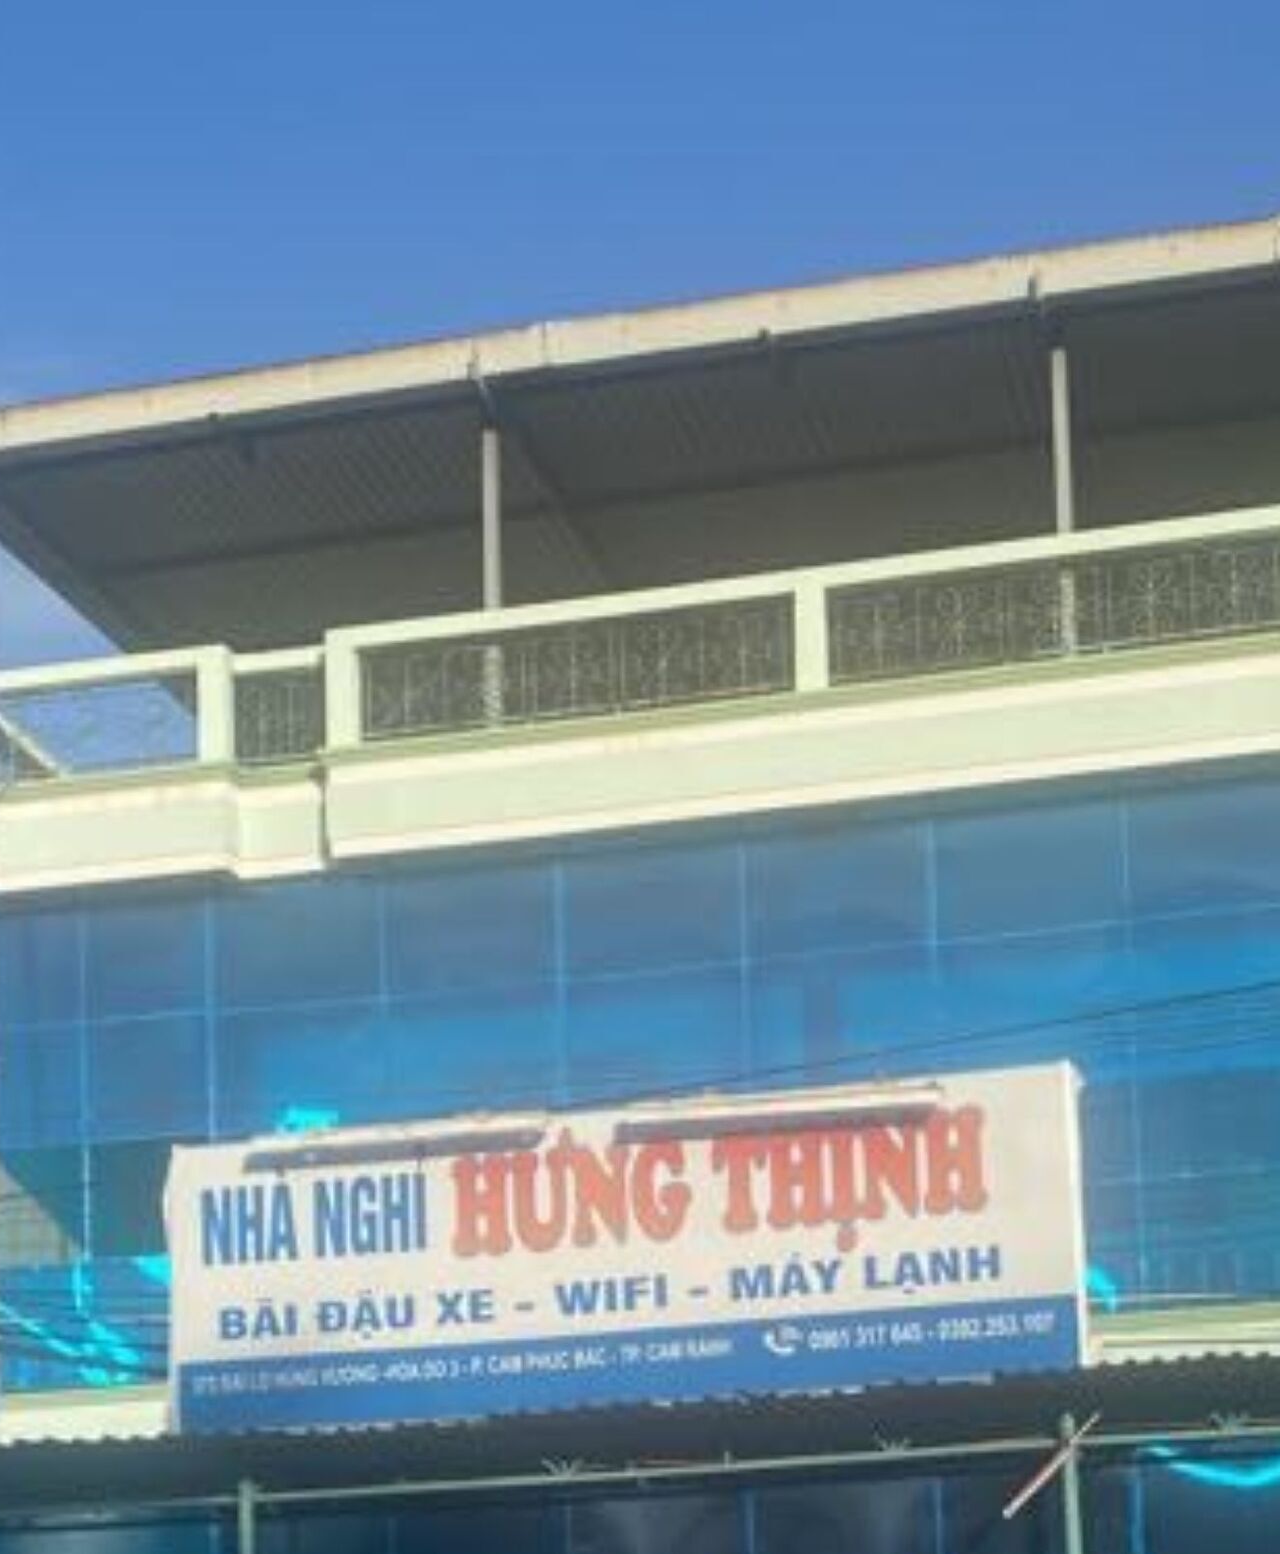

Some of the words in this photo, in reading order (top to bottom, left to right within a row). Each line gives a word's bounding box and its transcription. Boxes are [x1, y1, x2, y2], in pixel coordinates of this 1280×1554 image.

[712, 1106, 988, 1252] THỊNH
[219, 1297, 298, 1340] BÃI
[316, 1289, 415, 1339] ĐẬU
[436, 1288, 494, 1325] XE
[554, 1273, 668, 1315] WIFI
[728, 1252, 841, 1300] MÁY
[863, 1245, 1000, 1295] LẠNH
